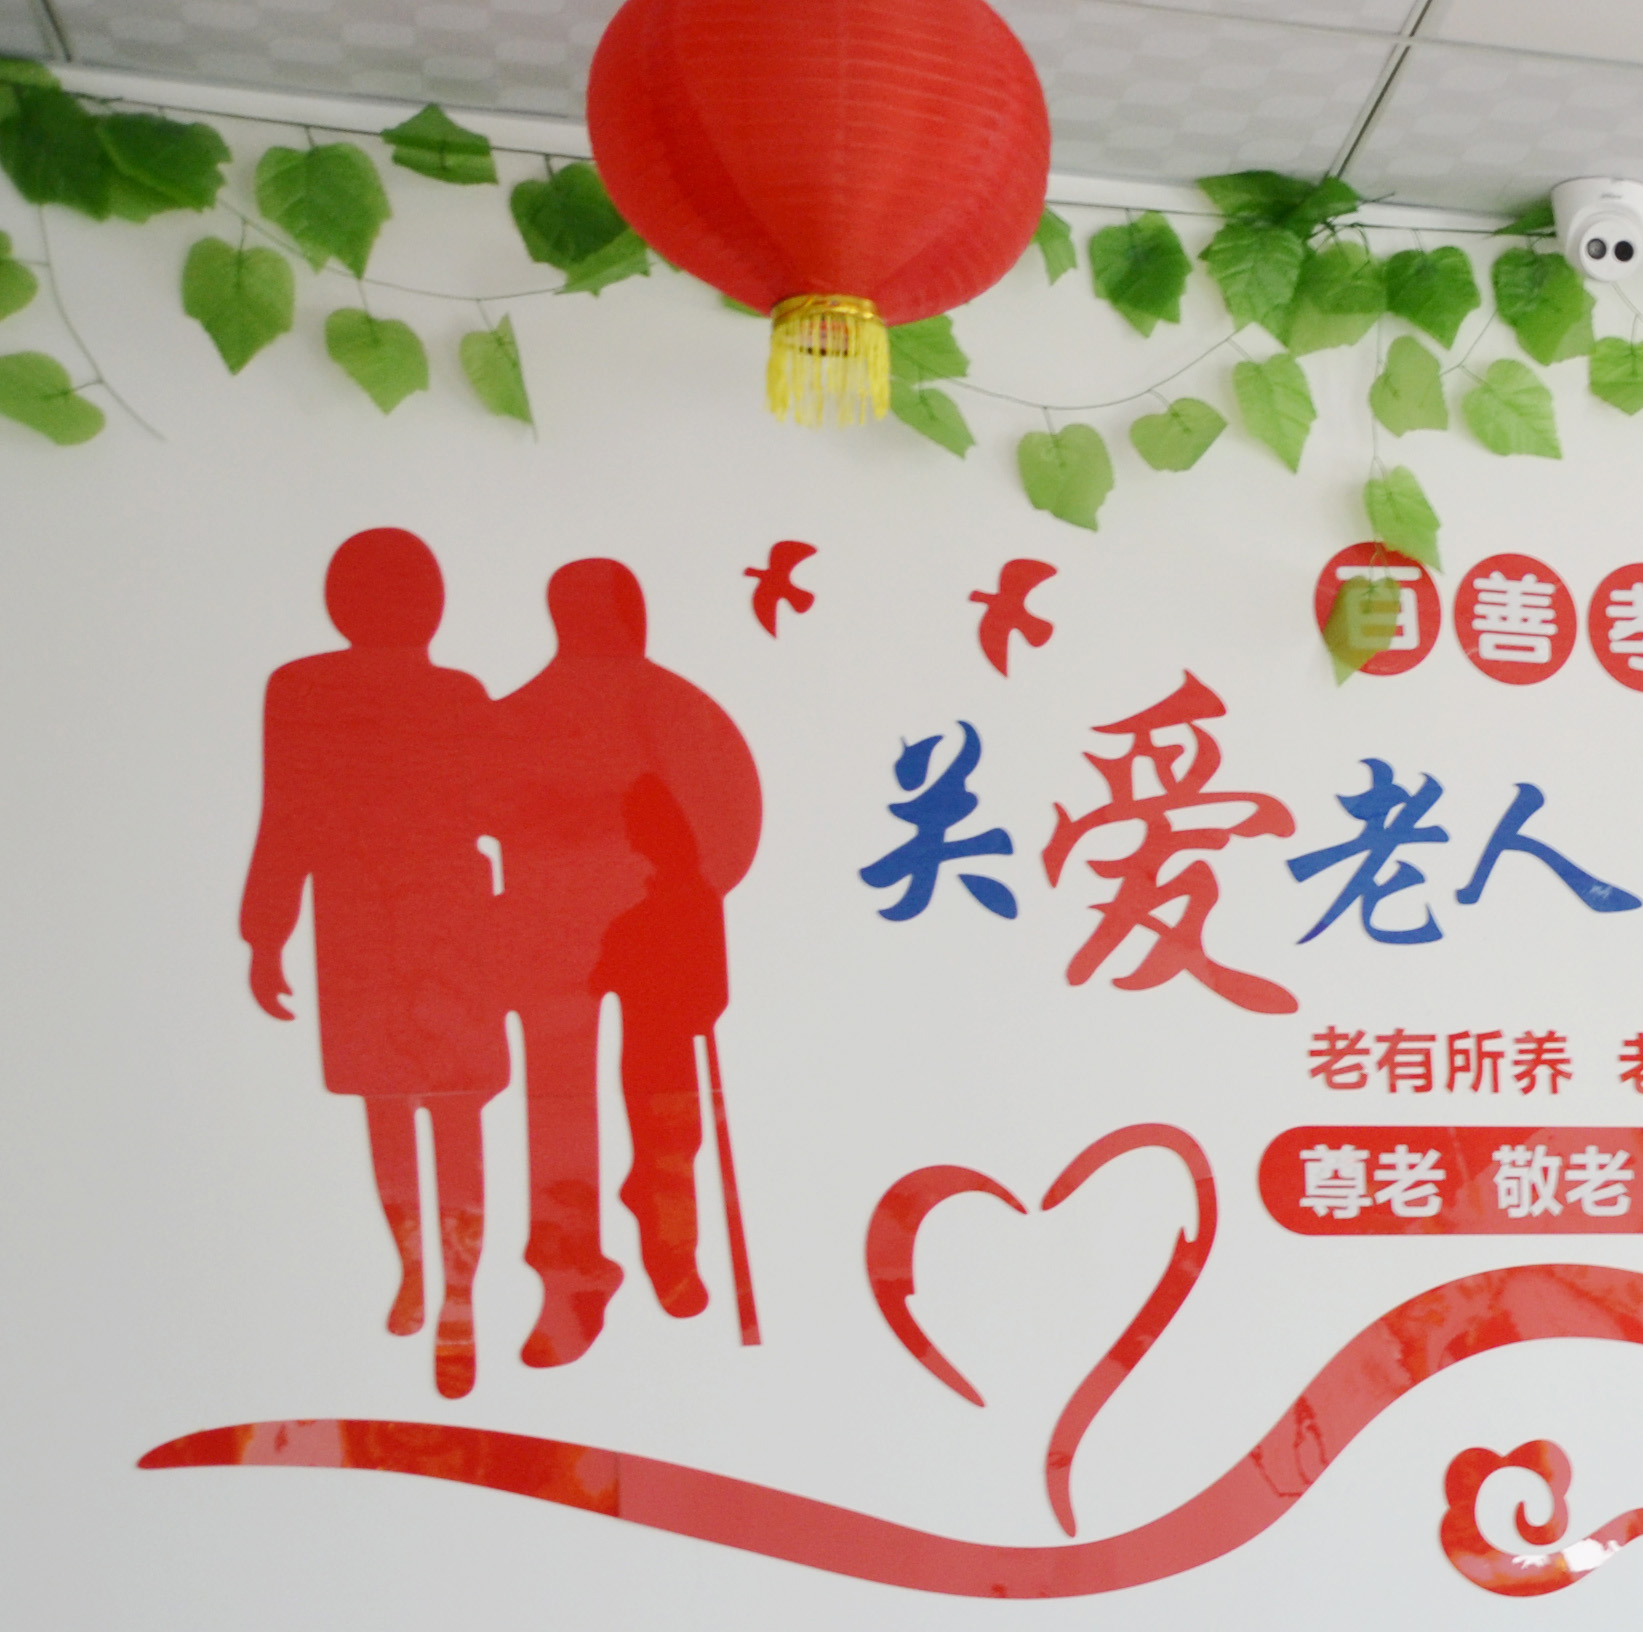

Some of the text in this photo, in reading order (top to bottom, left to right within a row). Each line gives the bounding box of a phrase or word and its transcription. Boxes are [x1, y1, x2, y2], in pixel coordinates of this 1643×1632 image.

[857, 668, 1643, 1016] 关爱老人
[1308, 1025, 1573, 1095] 老有所养
[1300, 1144, 1445, 1219] 尊老
[1492, 1145, 1634, 1218] 敬老
